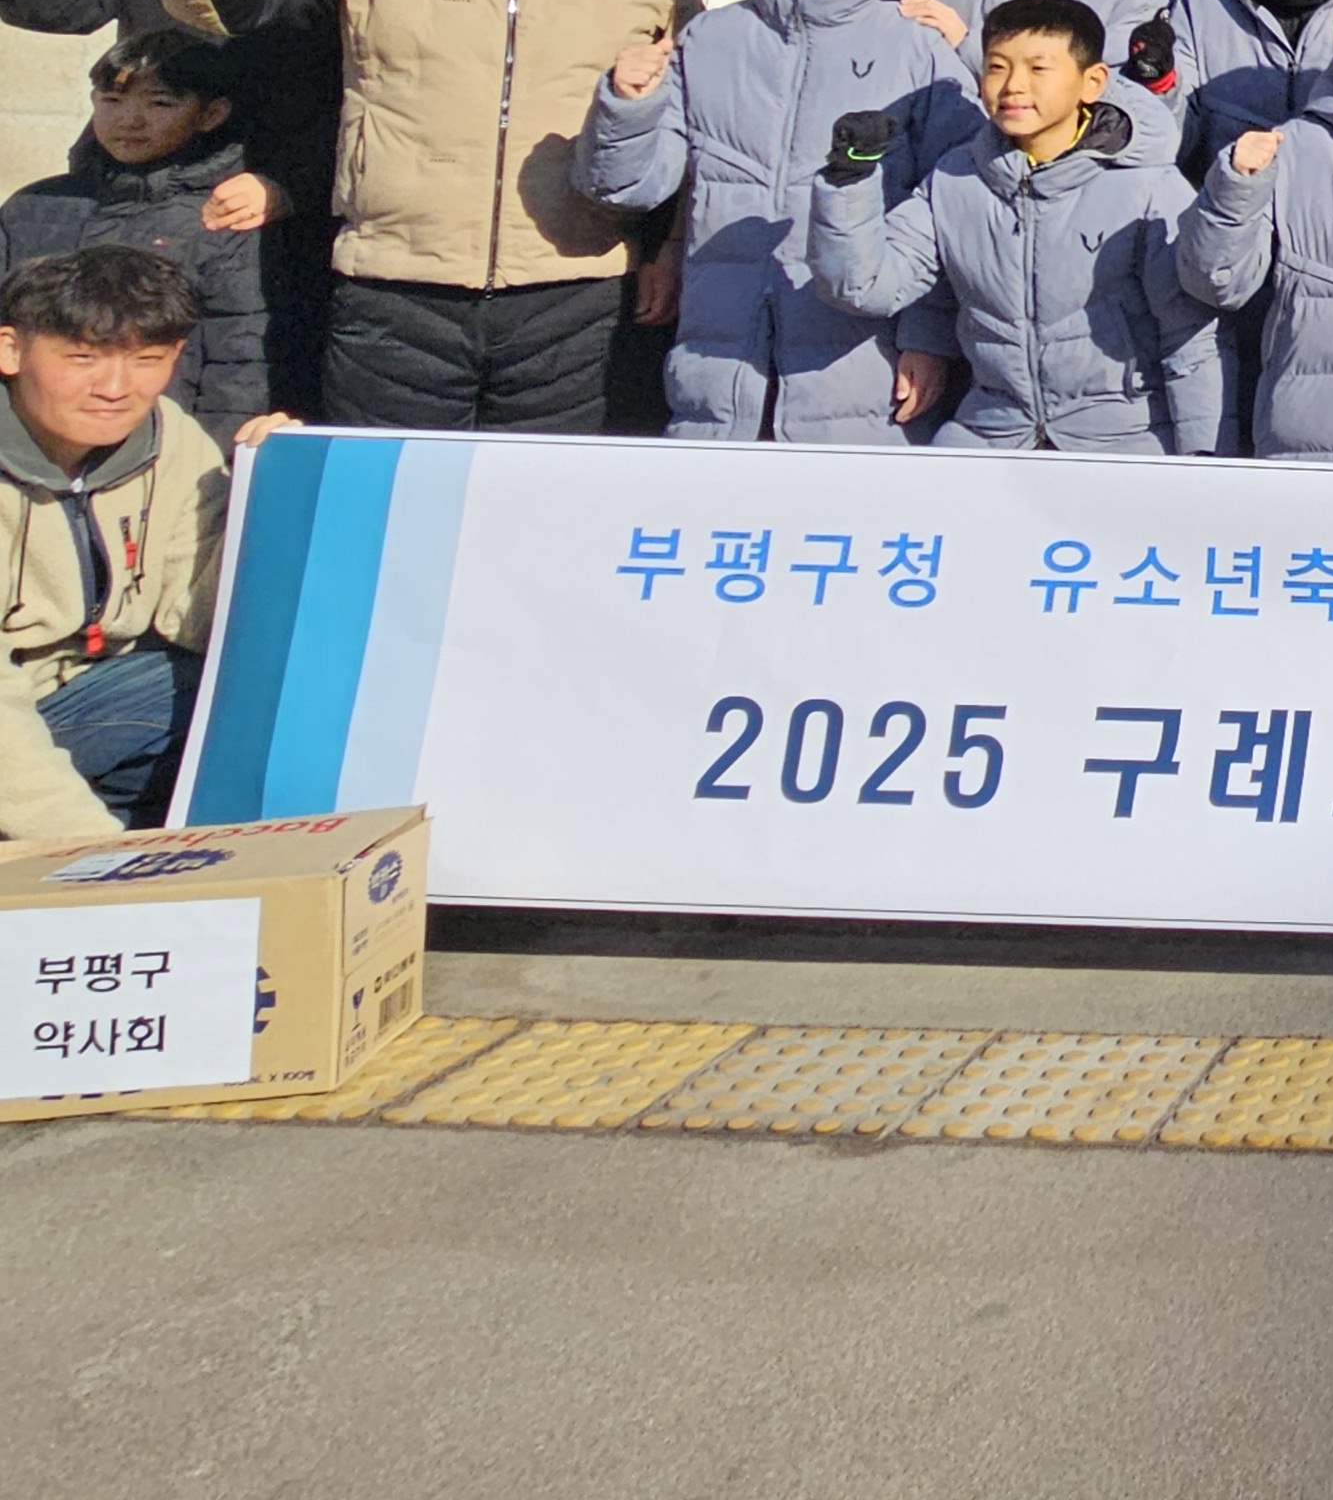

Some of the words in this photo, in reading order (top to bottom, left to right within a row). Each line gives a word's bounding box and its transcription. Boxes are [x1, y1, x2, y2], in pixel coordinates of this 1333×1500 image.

[616, 527, 943, 608] 부평구청
[693, 695, 1008, 809] 2025
[35, 950, 171, 995] 부평구
[33, 1014, 167, 1058] 약사회
